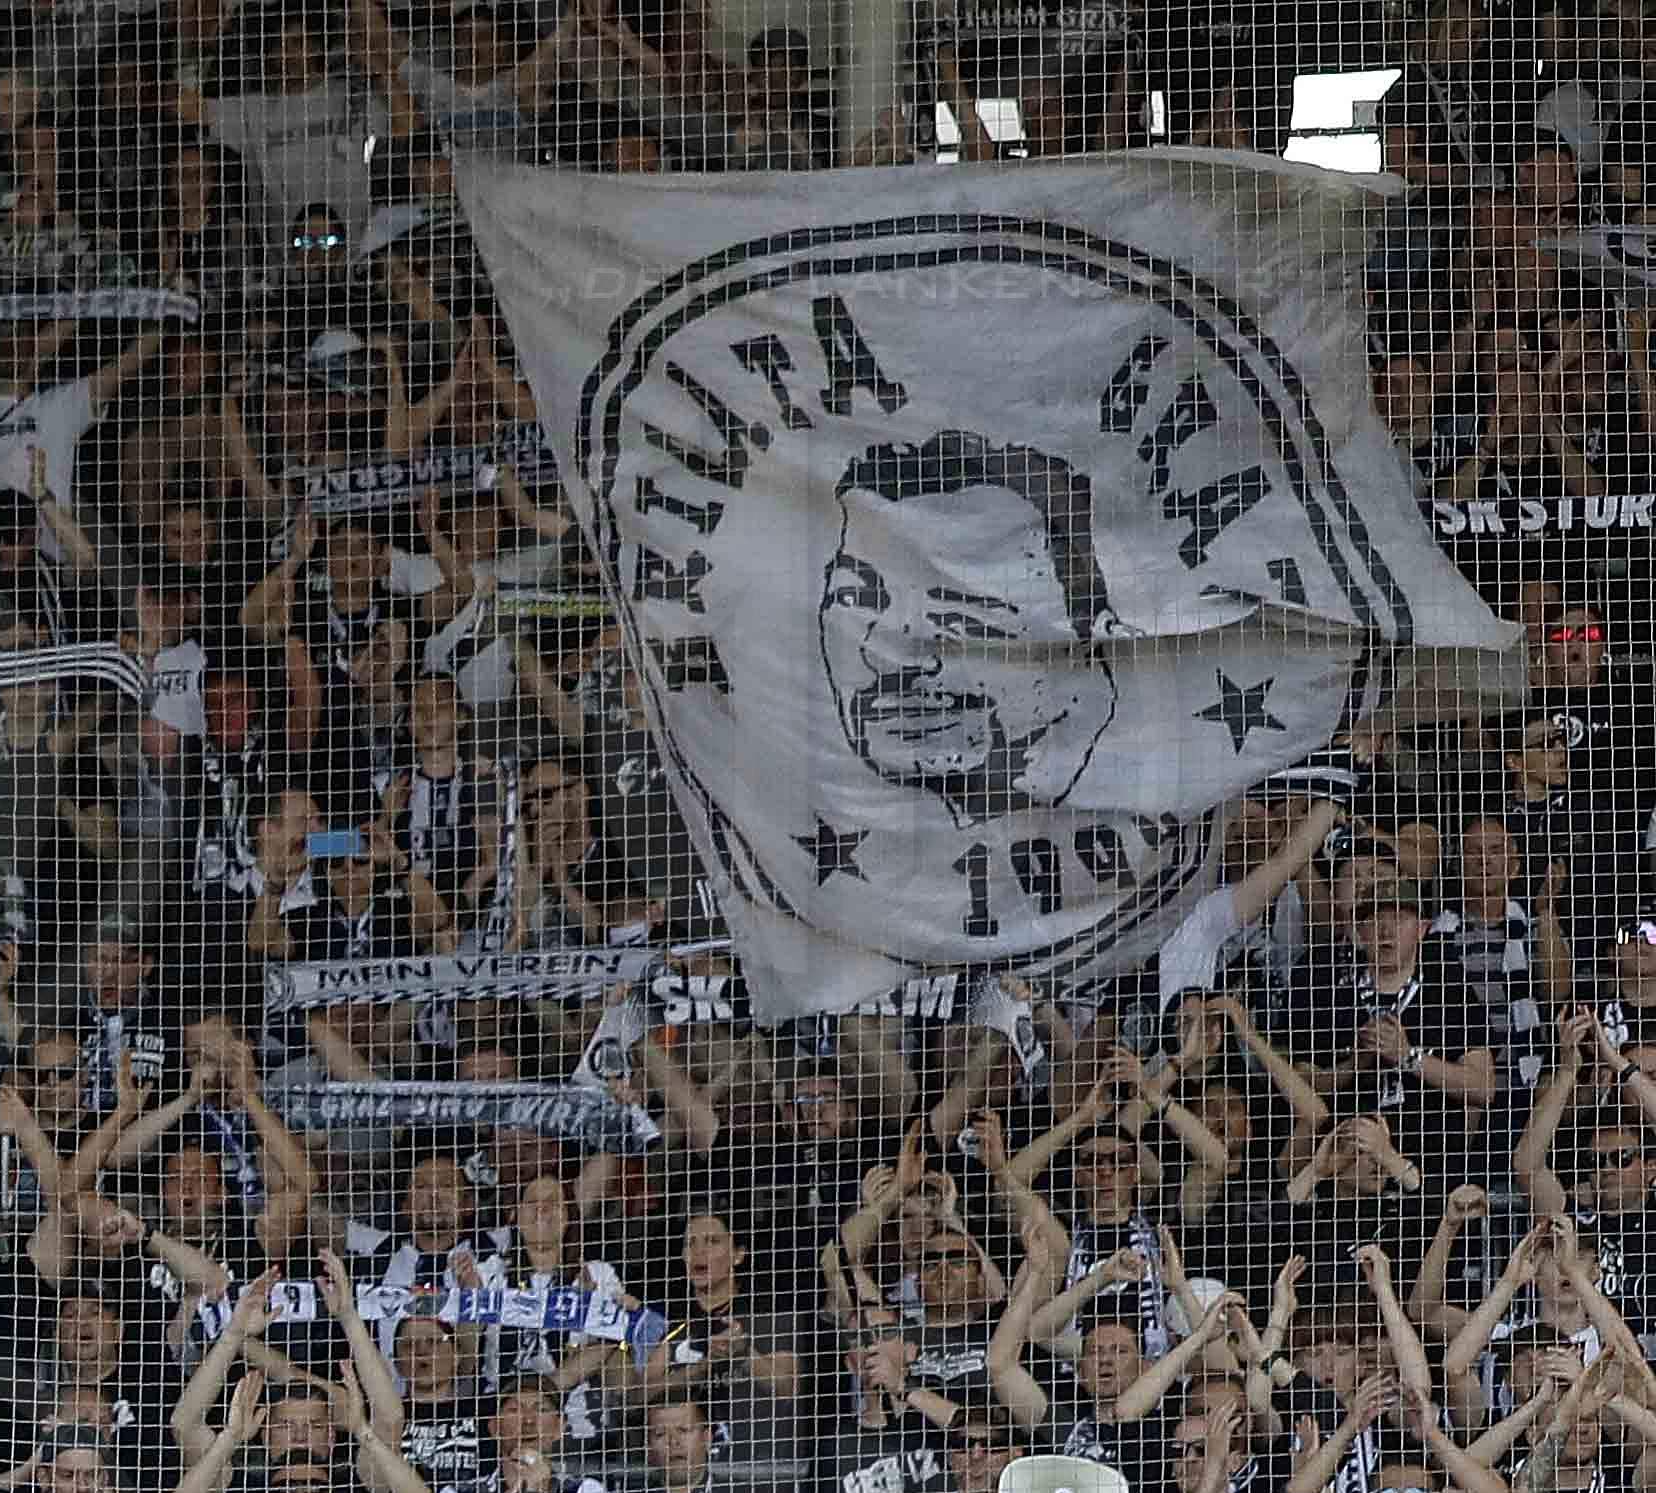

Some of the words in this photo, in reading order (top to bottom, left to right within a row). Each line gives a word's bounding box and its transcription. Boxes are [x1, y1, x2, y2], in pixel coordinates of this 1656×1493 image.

[1435, 497, 1507, 537] SK
[318, 961, 434, 989] MEIN
[454, 952, 624, 984] VEREIN
